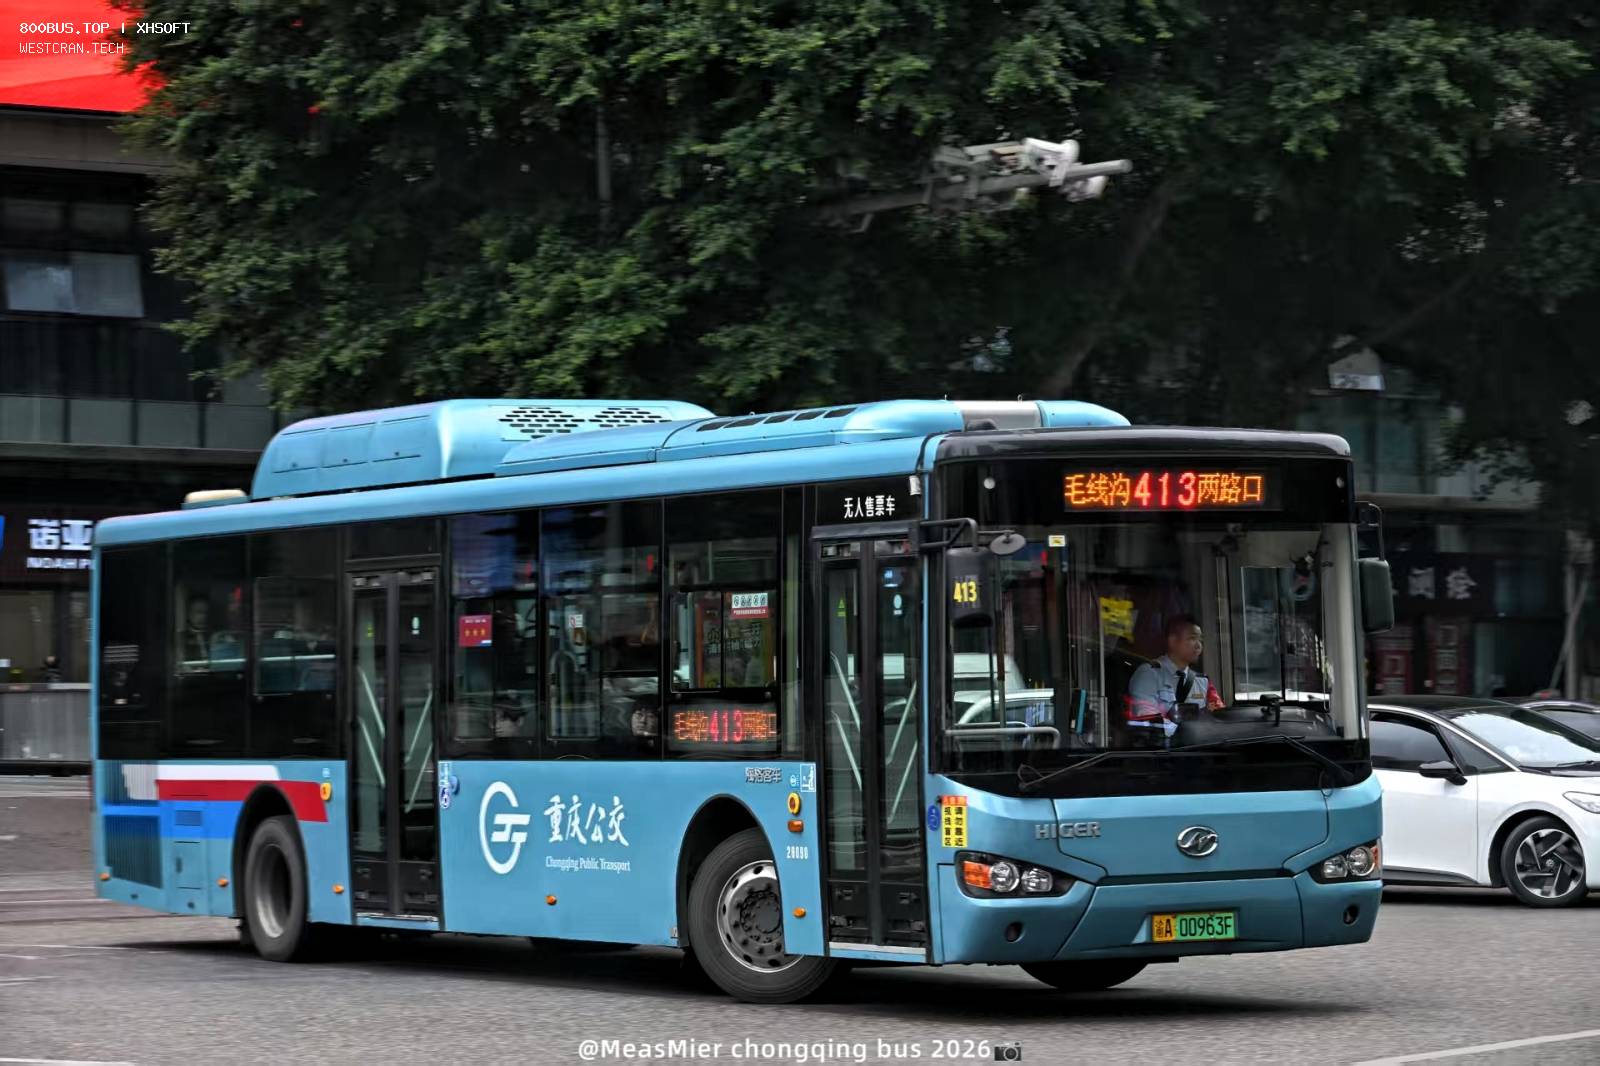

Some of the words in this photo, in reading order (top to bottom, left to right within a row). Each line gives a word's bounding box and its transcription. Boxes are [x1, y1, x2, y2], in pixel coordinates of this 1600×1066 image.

[1133, 472, 1196, 506] 413
[843, 494, 896, 519] 无人售票车
[953, 580, 978, 603] 413
[543, 794, 630, 847] 重庆公交
[1034, 821, 1101, 840] HIGER
[579, 857, 600, 870] Public
[600, 858, 631, 874] Transport
